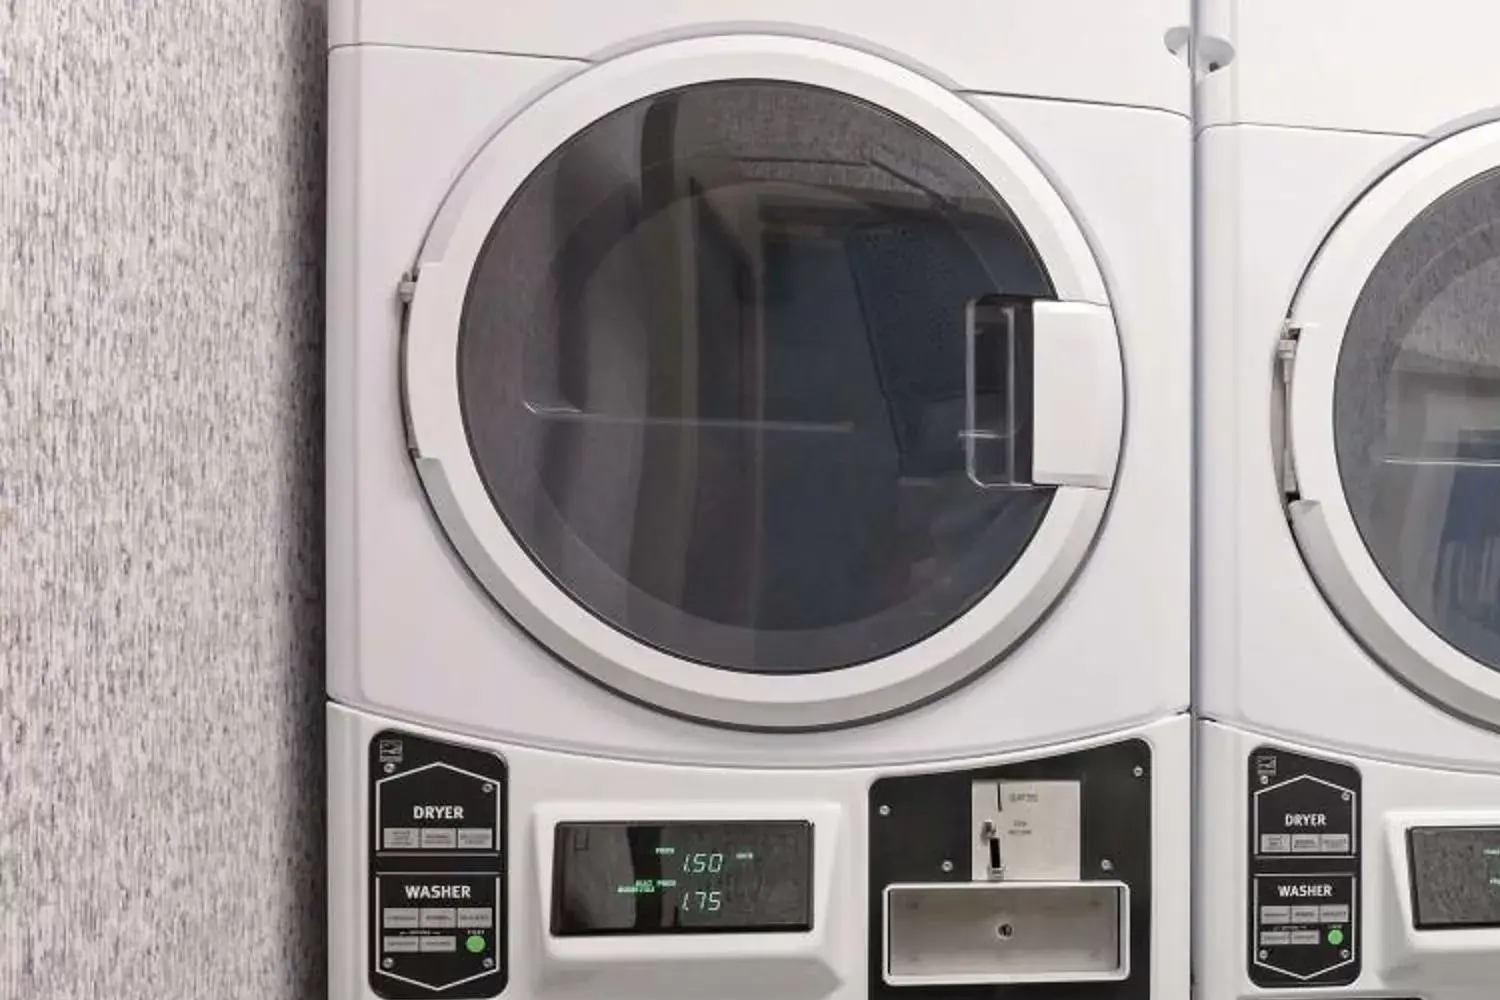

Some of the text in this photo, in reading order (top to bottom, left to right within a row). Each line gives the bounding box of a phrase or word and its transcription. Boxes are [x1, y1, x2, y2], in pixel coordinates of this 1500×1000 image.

[413, 805, 465, 819] DRYER
[1285, 813, 1326, 827] DRYER
[683, 853, 724, 873] 1.50
[405, 885, 471, 899] WASHER
[1278, 884, 1333, 897] WASHER
